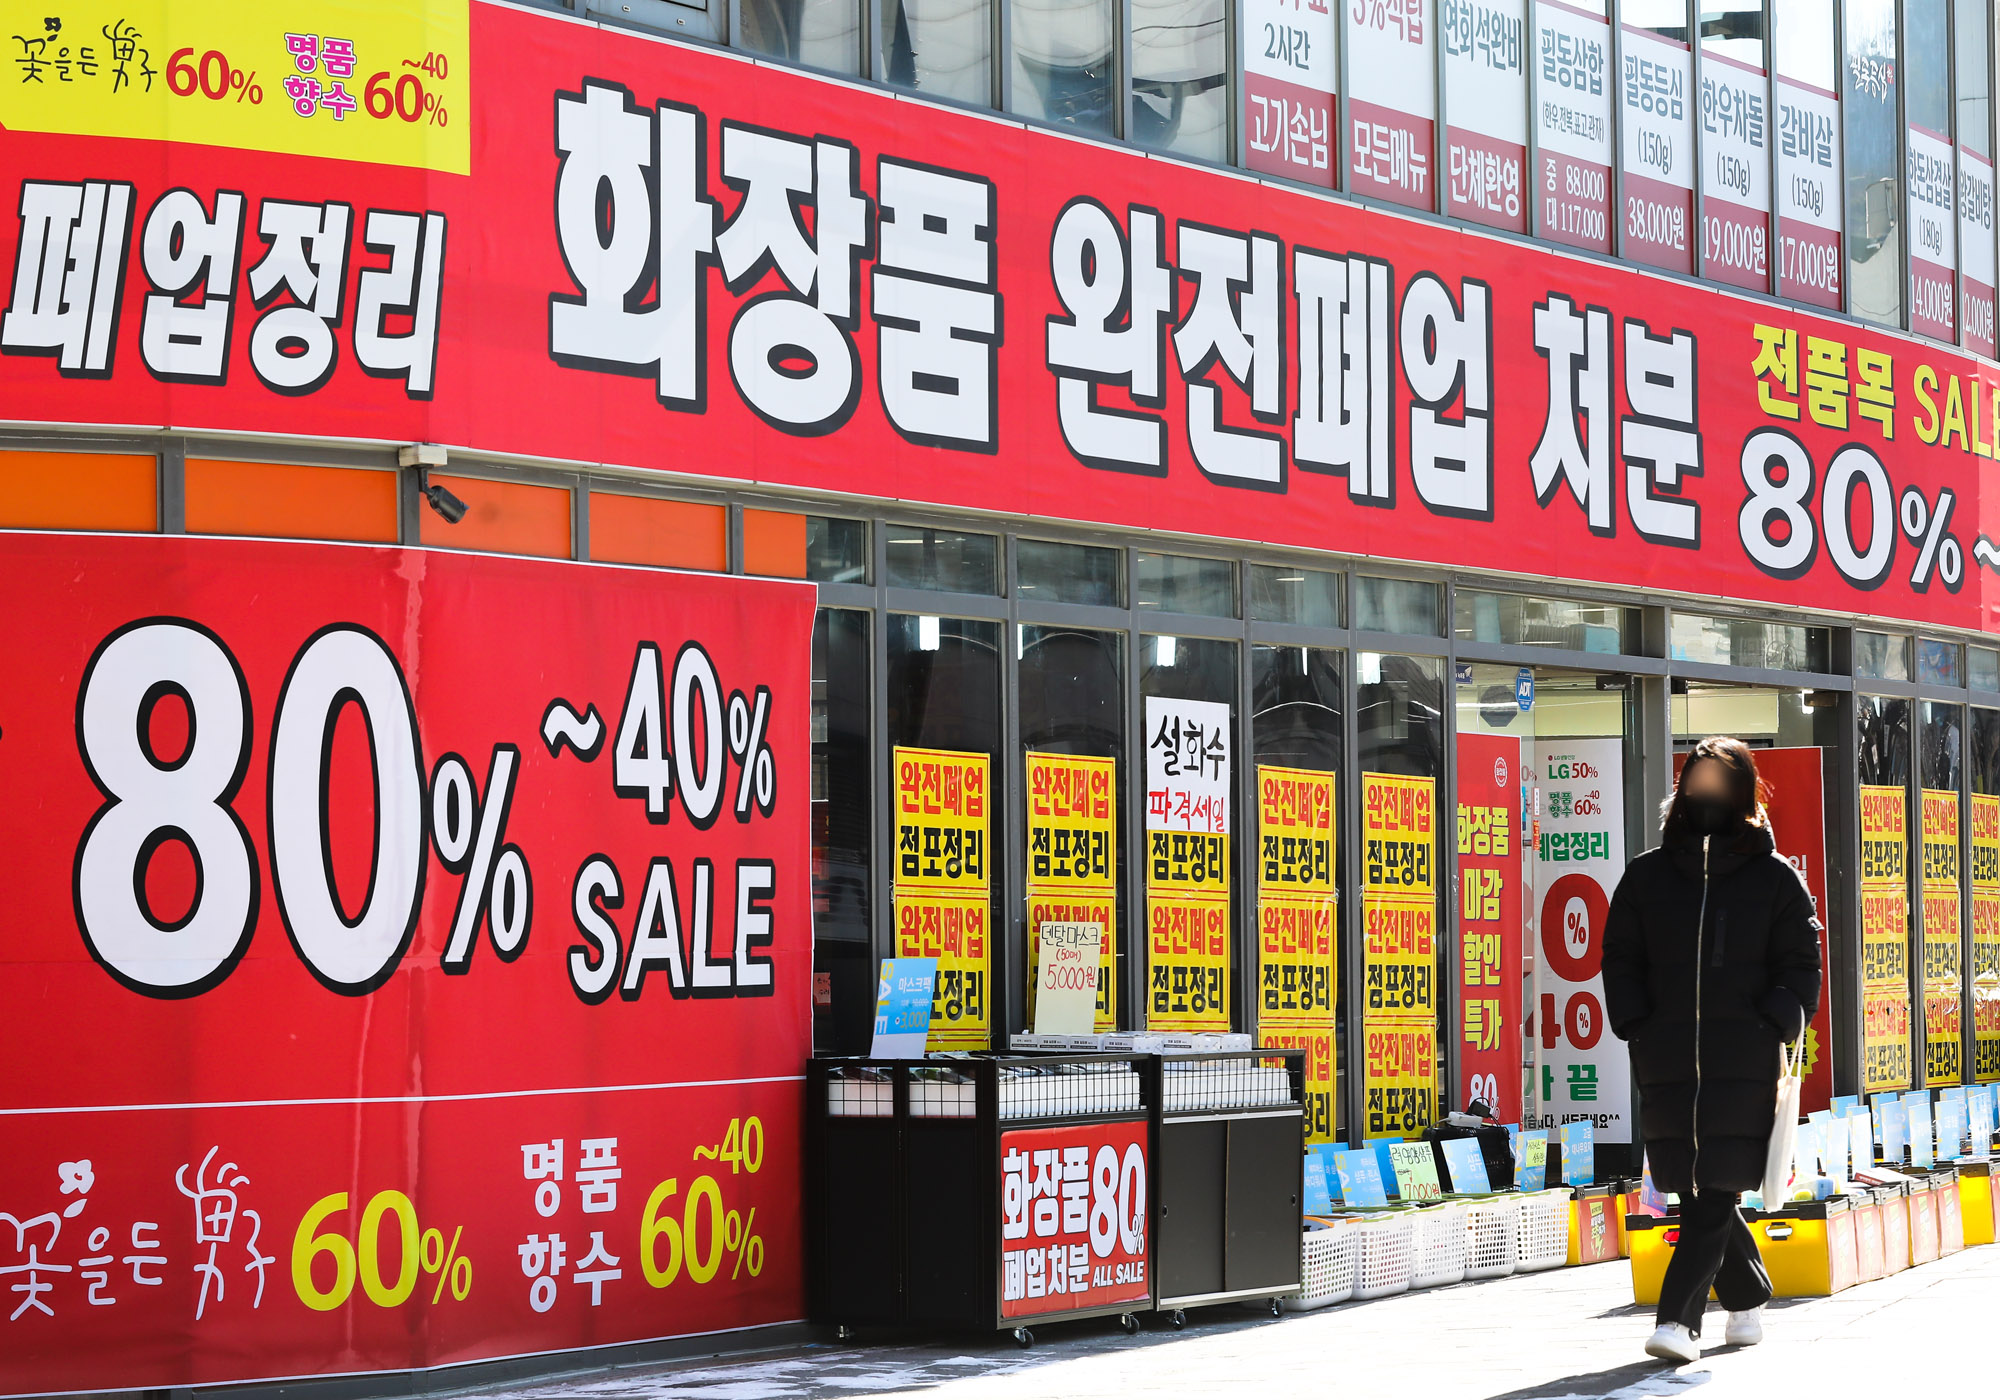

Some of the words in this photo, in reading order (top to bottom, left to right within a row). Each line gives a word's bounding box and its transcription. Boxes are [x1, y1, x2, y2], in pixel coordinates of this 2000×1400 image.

[11, 33, 98, 84] 꽃을든
[283, 32, 357, 78] 명품
[1264, 22, 1311, 70] 2시간
[1444, 0, 1522, 75] 연회석완비
[1541, 27, 1604, 96] 필동삼합
[165, 47, 263, 105] 60%
[401, 51, 448, 81] ~40
[1624, 54, 1684, 121] 필동등심
[283, 74, 357, 121] 향수
[364, 70, 448, 128] 60%
[1702, 78, 1764, 148] 한우차돌
[1250, 94, 1328, 170] 고기손님
[1353, 118, 1428, 194] 모든메뉴
[1637, 127, 1673, 175] (150g)
[1780, 103, 1833, 168] 갈비살
[1450, 144, 1520, 217] 단체환영
[1545, 158, 1557, 192] 중
[1566, 164, 1605, 203] 88,000
[1716, 151, 1751, 196] (150g)
[1791, 173, 1824, 217] (150g)
[1546, 197, 1557, 231] 대
[1561, 202, 1606, 241] 117,000
[1628, 196, 1685, 251] 38,000원
[1919, 215, 1942, 256] (180g)
[1703, 214, 1766, 276] 19,000원
[1779, 235, 1839, 294] 17,000원
[0, 178, 447, 401] 폐업정리
[548, 76, 1004, 455] 화장품
[1045, 195, 1494, 522] 완전폐업
[1529, 290, 1704, 550] 처분
[1911, 273, 1953, 328] 14,000원
[1751, 322, 1896, 441] 전품목
[1738, 425, 1965, 594] 80%
[1518, 682, 1532, 698] ADT
[540, 639, 777, 831] ~40%
[1150, 714, 1226, 782] 설화수
[900, 761, 983, 818] 완전폐업
[1032, 765, 1109, 819] 완전폐업
[1548, 764, 1570, 779] LG
[1571, 762, 1598, 779] 50%
[72, 615, 533, 1000] 80%
[1148, 787, 1225, 832] 파격세일
[1263, 778, 1330, 829] 완전폐업
[1367, 785, 1431, 832] 완전폐업
[1574, 799, 1601, 816] 60%
[1863, 795, 1902, 832] 완전폐업
[1924, 798, 1957, 836] 완전폐업
[1972, 802, 1998, 840] 완전폐업
[900, 825, 983, 880] 점포정리
[1032, 829, 1109, 879] 점포정리
[1457, 802, 1509, 857] 화장품
[1152, 833, 1223, 884] 점포정리
[1263, 836, 1330, 885] 점포정리
[1367, 840, 1431, 886] 점포정리
[1863, 841, 1903, 878] 점포정리
[1924, 843, 1957, 880] 점포정리
[1972, 846, 1999, 882] 점포정리
[1463, 869, 1503, 921] 마감
[1864, 897, 1904, 934] 완전폐업
[1924, 898, 1957, 935] 완전폐업
[568, 852, 775, 1006] SALE
[900, 904, 983, 959] 완전폐업
[1041, 925, 1100, 948] 덴탈마스크
[1153, 906, 1223, 955] 완전폐업
[1263, 906, 1330, 955] 완전폐업
[1367, 908, 1431, 955] 완전폐업
[1056, 949, 1081, 962] (50매)
[1463, 931, 1502, 986] 할인
[1865, 942, 1905, 979] 점포정리
[1925, 943, 1957, 978] 점포정리
[876, 962, 893, 1034] SALE
[898, 976, 932, 993] 마스크팩
[930, 970, 983, 1021] 정리
[1152, 965, 1223, 1014] 점포정리
[1263, 963, 1330, 1013] 점포정리
[1367, 964, 1431, 1010] 점포정리
[1464, 999, 1503, 1051] 특가
[1368, 1033, 1431, 1077] 완전폐업
[1867, 1044, 1906, 1083] 점포정리
[1927, 1041, 1958, 1077] 점포정리
[1567, 1064, 1598, 1101] 끝
[1368, 1088, 1431, 1133] 점포정리
[693, 1116, 764, 1175] ~40
[1467, 1154, 1482, 1173] 샴푸
[520, 1137, 622, 1218] 명품
[1003, 1147, 1090, 1240] 화장품
[1089, 1142, 1146, 1258] 80%
[291, 1189, 472, 1312] 60%
[640, 1175, 764, 1289] 60%
[0, 1211, 168, 1321] 꽃을든
[517, 1231, 622, 1313] 향수
[1003, 1242, 1090, 1301] 폐업처분
[1092, 1264, 1114, 1288] ALL
[1115, 1261, 1145, 1285] SALE
